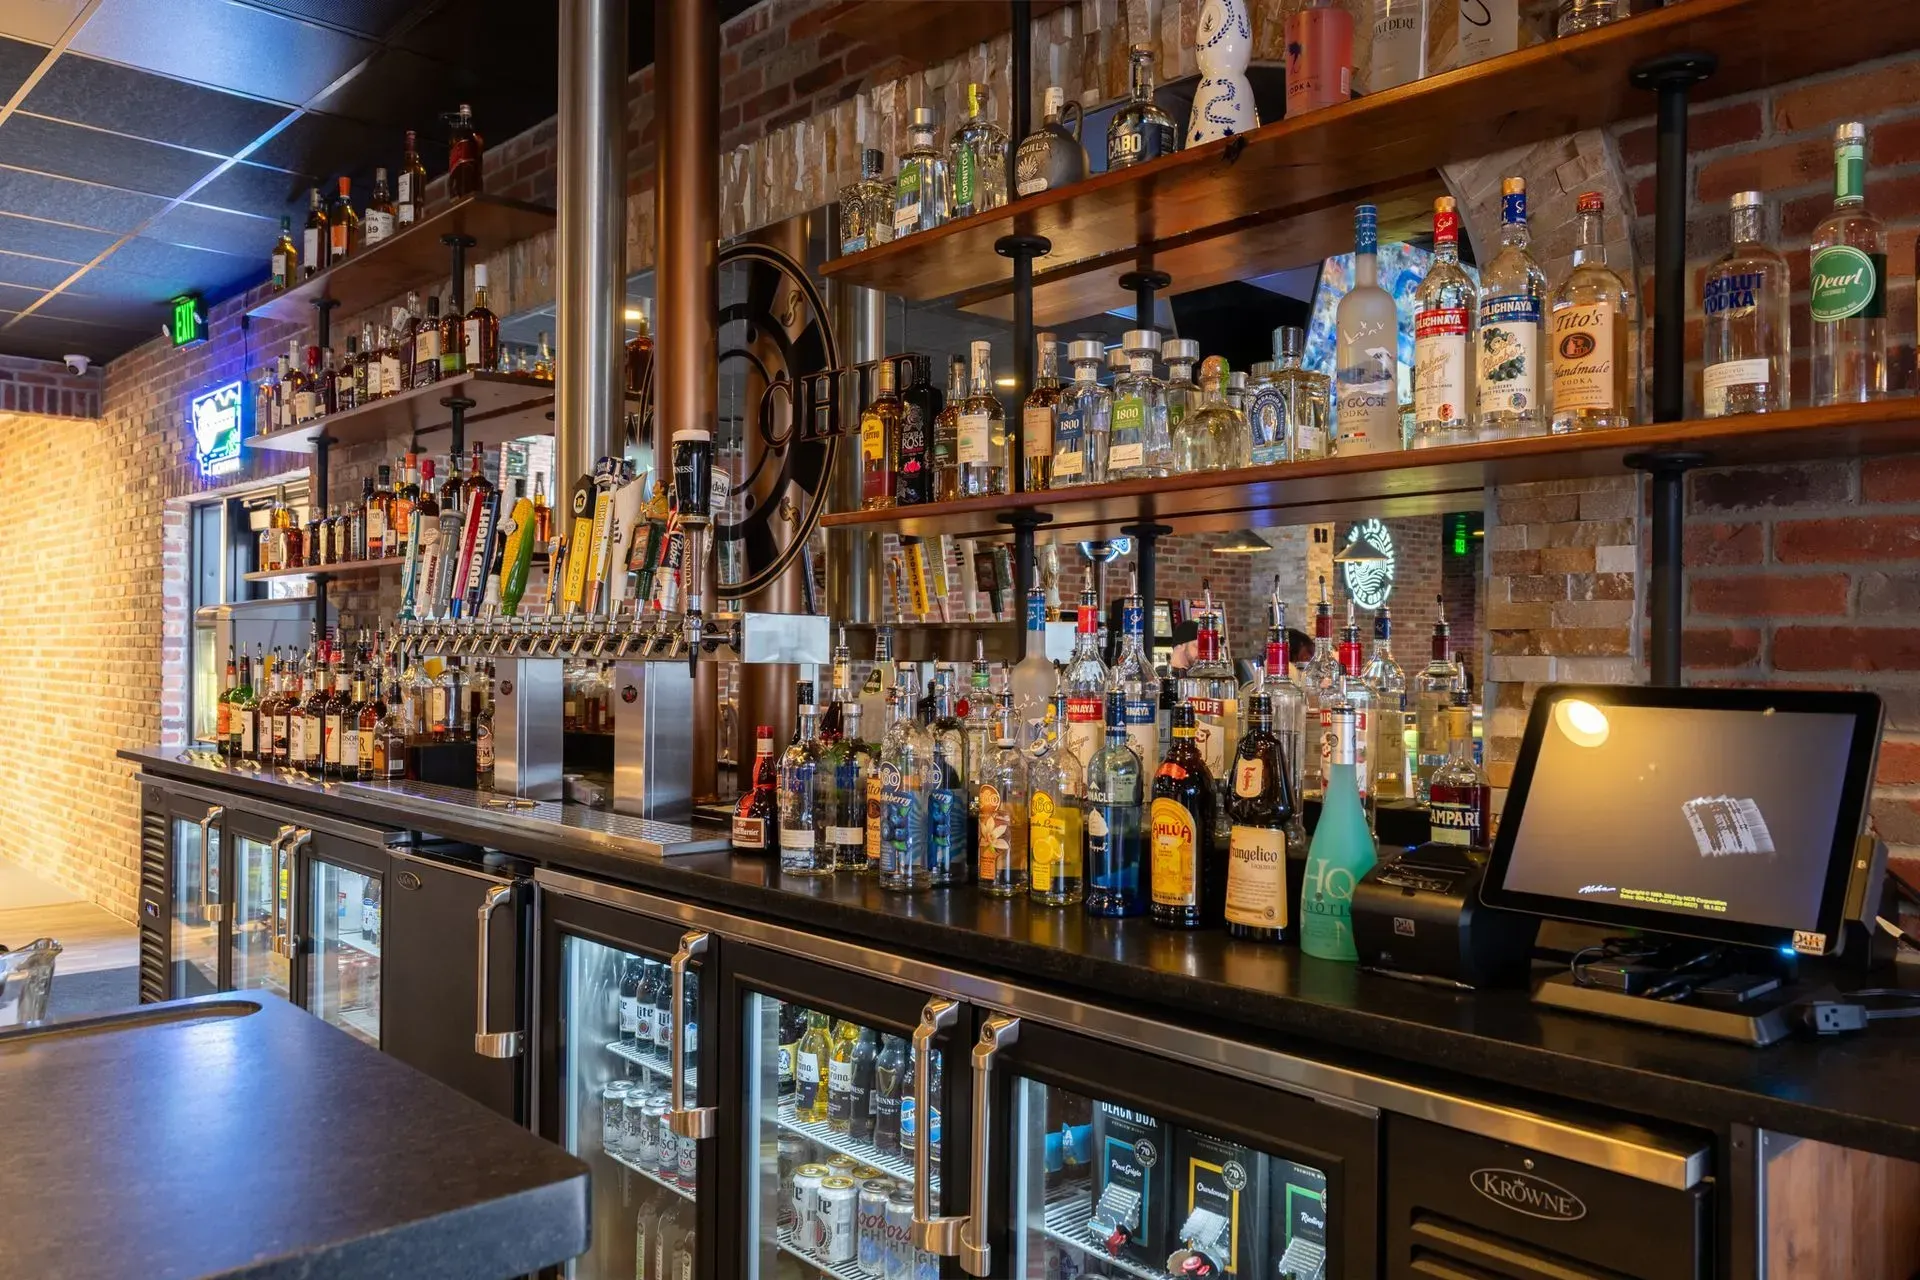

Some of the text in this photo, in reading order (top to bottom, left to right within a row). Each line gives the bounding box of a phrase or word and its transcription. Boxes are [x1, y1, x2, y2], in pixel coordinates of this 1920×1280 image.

[1374, 17, 1415, 35] VEDERE
[1108, 133, 1142, 160] CABO
[1811, 268, 1864, 301] Pearl
[1481, 301, 1533, 317] TOLICHNAYA
[1704, 290, 1756, 315] VODKA
[175, 301, 195, 344] EXIT
[1417, 314, 1461, 329] LICHNAYA
[1561, 377, 1593, 387] VODKA
[1347, 396, 1387, 409] GOOSE
[1117, 408, 1138, 420] 1800
[1060, 418, 1080, 431] 1800
[902, 436, 925, 449] ROSE
[675, 464, 694, 474] NESS
[712, 481, 728, 494] delo
[468, 505, 491, 587] BUD LIGHT
[670, 537, 684, 567] Pabst
[684, 539, 692, 586] GUINNESS
[1067, 703, 1095, 714] CHNAYA
[1194, 701, 1219, 714] NOFF
[1430, 809, 1480, 827] AMPARI
[1231, 845, 1278, 863] rangelico
[636, 1005, 653, 1019] Lite
[658, 1012, 669, 1026] Lit
[830, 1072, 849, 1082] rona
[1483, 1173, 1573, 1217] KROWNE
